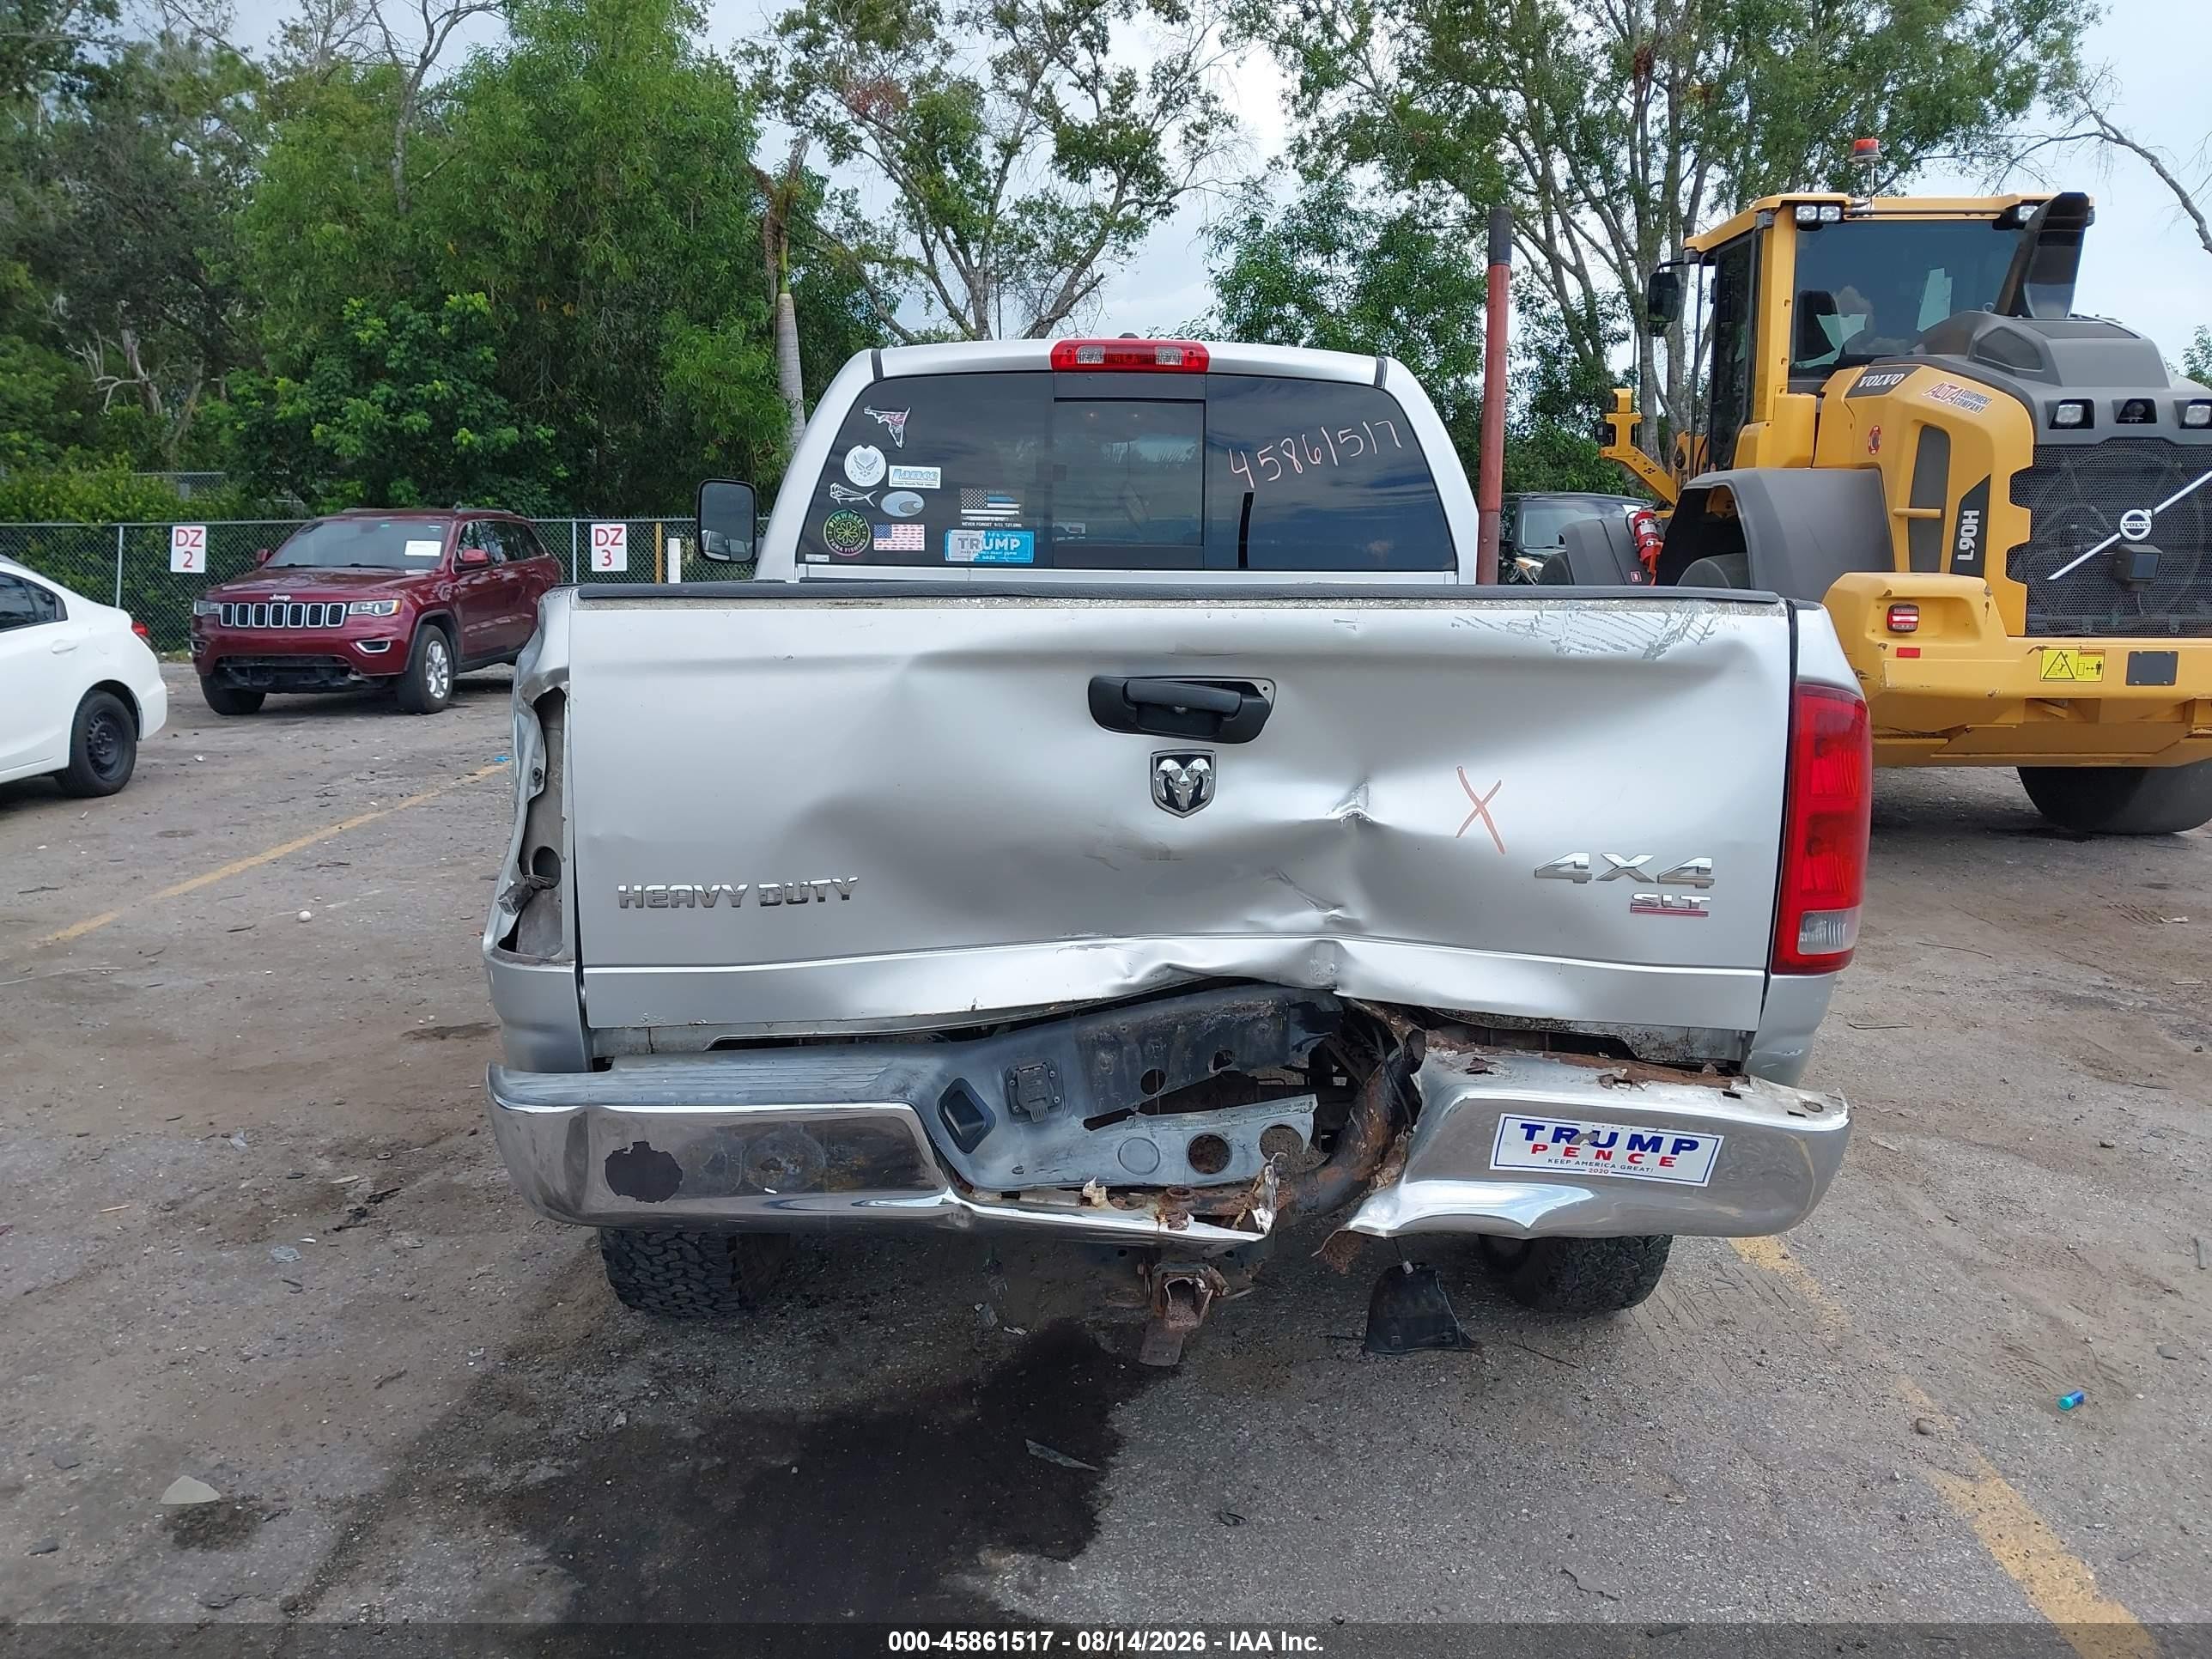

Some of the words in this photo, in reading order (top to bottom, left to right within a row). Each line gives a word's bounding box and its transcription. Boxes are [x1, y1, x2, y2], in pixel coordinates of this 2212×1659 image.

[1857, 373, 1905, 388] VOLVO
[1923, 382, 1964, 404] ALTA
[1960, 390, 1993, 406] EQUIPMENT
[1953, 398, 1986, 414] COMPANY
[1228, 420, 1402, 489] 45861517
[829, 513, 866, 528] PINWHEEL
[175, 530, 203, 548] DZ
[595, 528, 623, 547] DZ
[957, 537, 1021, 550] TRUMP
[1958, 510, 1980, 561] L90H
[830, 538, 843, 552] TUNA
[845, 538, 866, 553] FISHING
[183, 551, 193, 568] 2
[601, 550, 612, 567] 3
[269, 593, 291, 602] Jeep
[1534, 852, 1716, 889] 4X4
[617, 883, 749, 908] HEAVY
[757, 876, 859, 907] DUTY
[1632, 893, 1712, 910] SLT
[1519, 1122, 1700, 1156] TRUMP
[1530, 1143, 1678, 1169] PENCE
[1547, 1158, 1572, 1166] KEEP
[1575, 1160, 1617, 1170] AMERICA
[1620, 1164, 1654, 1173] GREAT!
